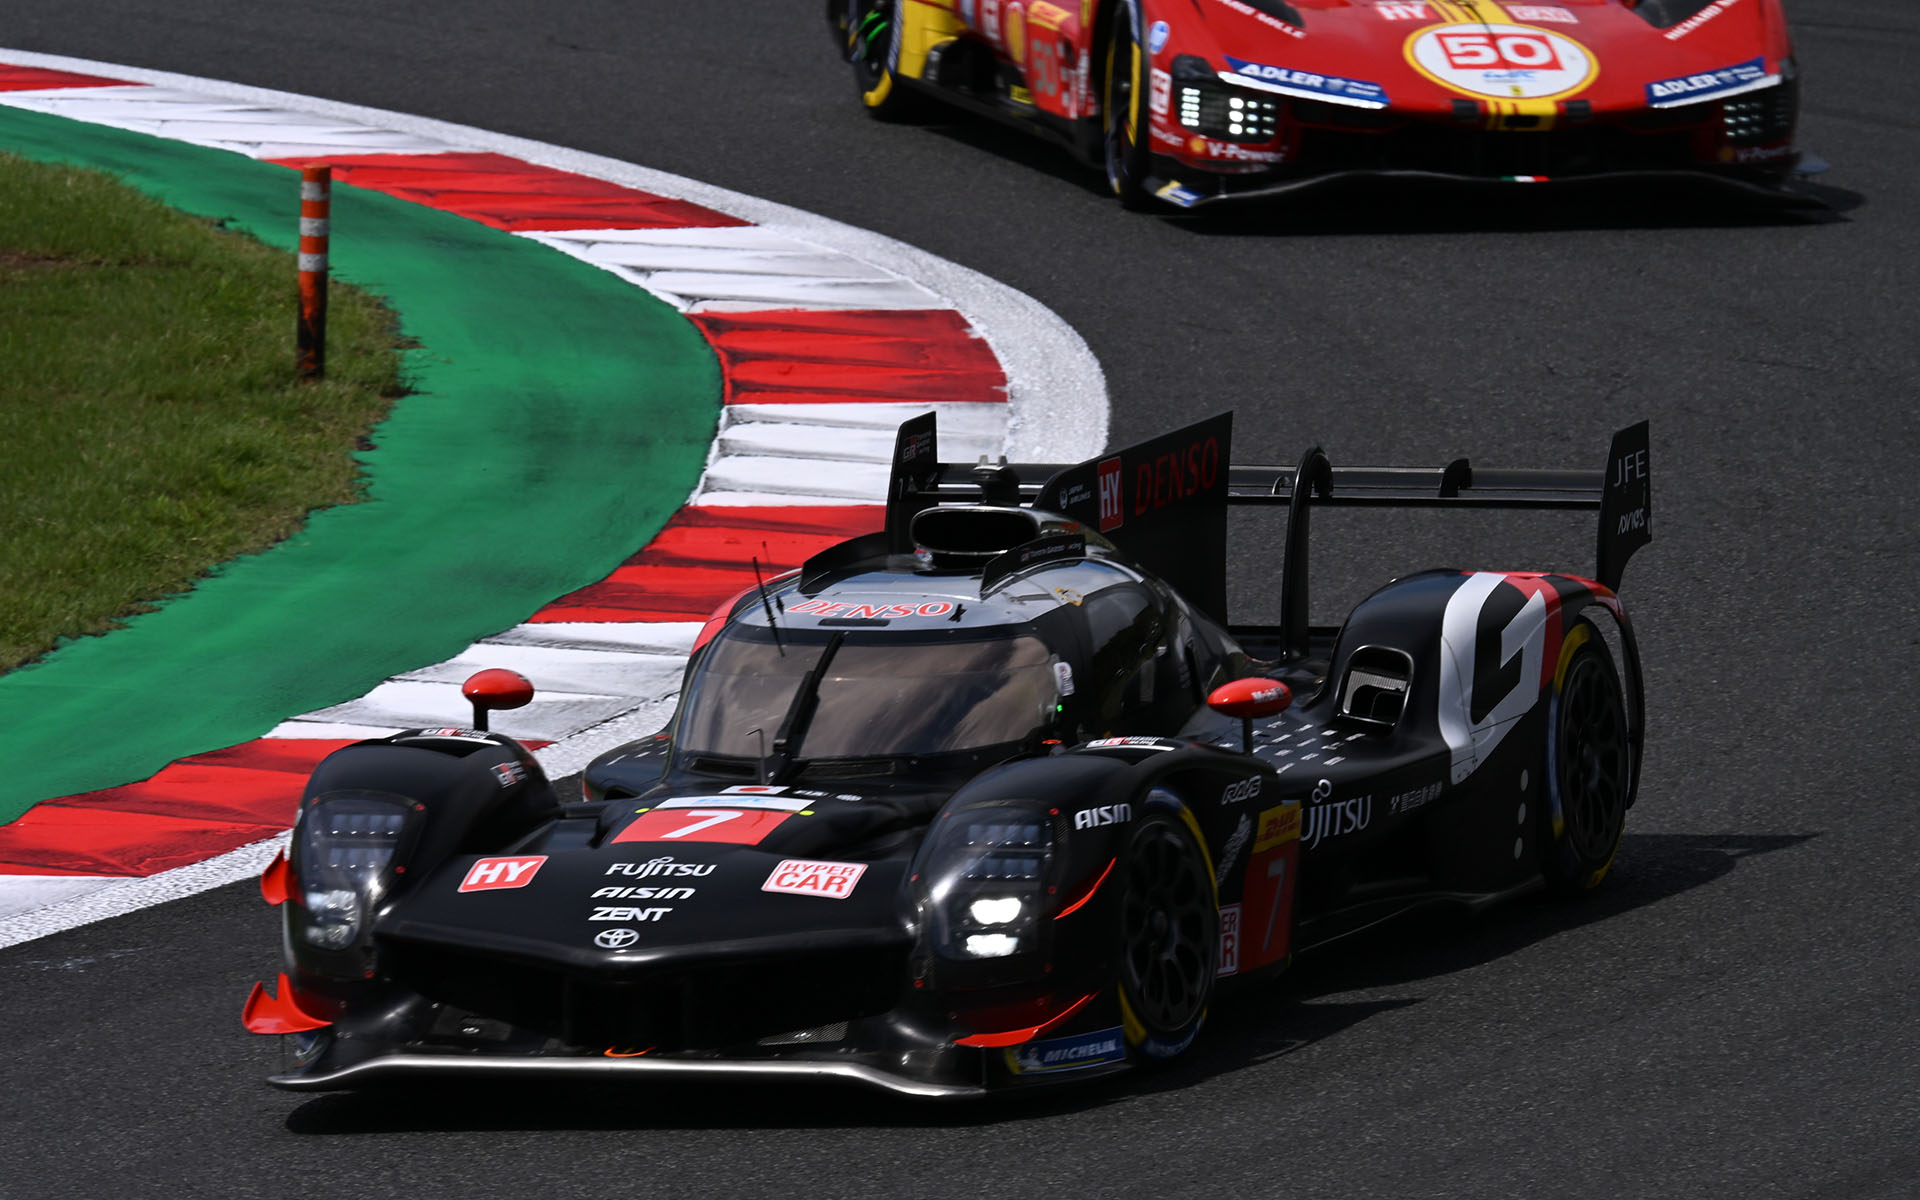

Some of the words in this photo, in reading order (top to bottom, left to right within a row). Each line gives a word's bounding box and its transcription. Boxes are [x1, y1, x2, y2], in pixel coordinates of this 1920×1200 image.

[1376, 4, 1428, 20] HY
[1439, 35, 1553, 66] 50
[1237, 63, 1325, 88] ADLER
[1651, 73, 1722, 97] ADLER
[1135, 436, 1219, 517] DENSO
[1613, 449, 1647, 488] JFE
[1100, 470, 1121, 522] HY
[786, 600, 954, 619] DENSO
[660, 810, 744, 838] 7
[1074, 803, 1132, 830] AISIN
[467, 860, 538, 886] HY
[605, 857, 718, 880] FUJITSU
[783, 861, 856, 877] HYPER
[590, 886, 696, 900] AISIN
[775, 872, 849, 893] CAR
[588, 906, 673, 922] ZENT
[1265, 858, 1287, 952] 7
[1044, 1037, 1117, 1063] MICHELIN
